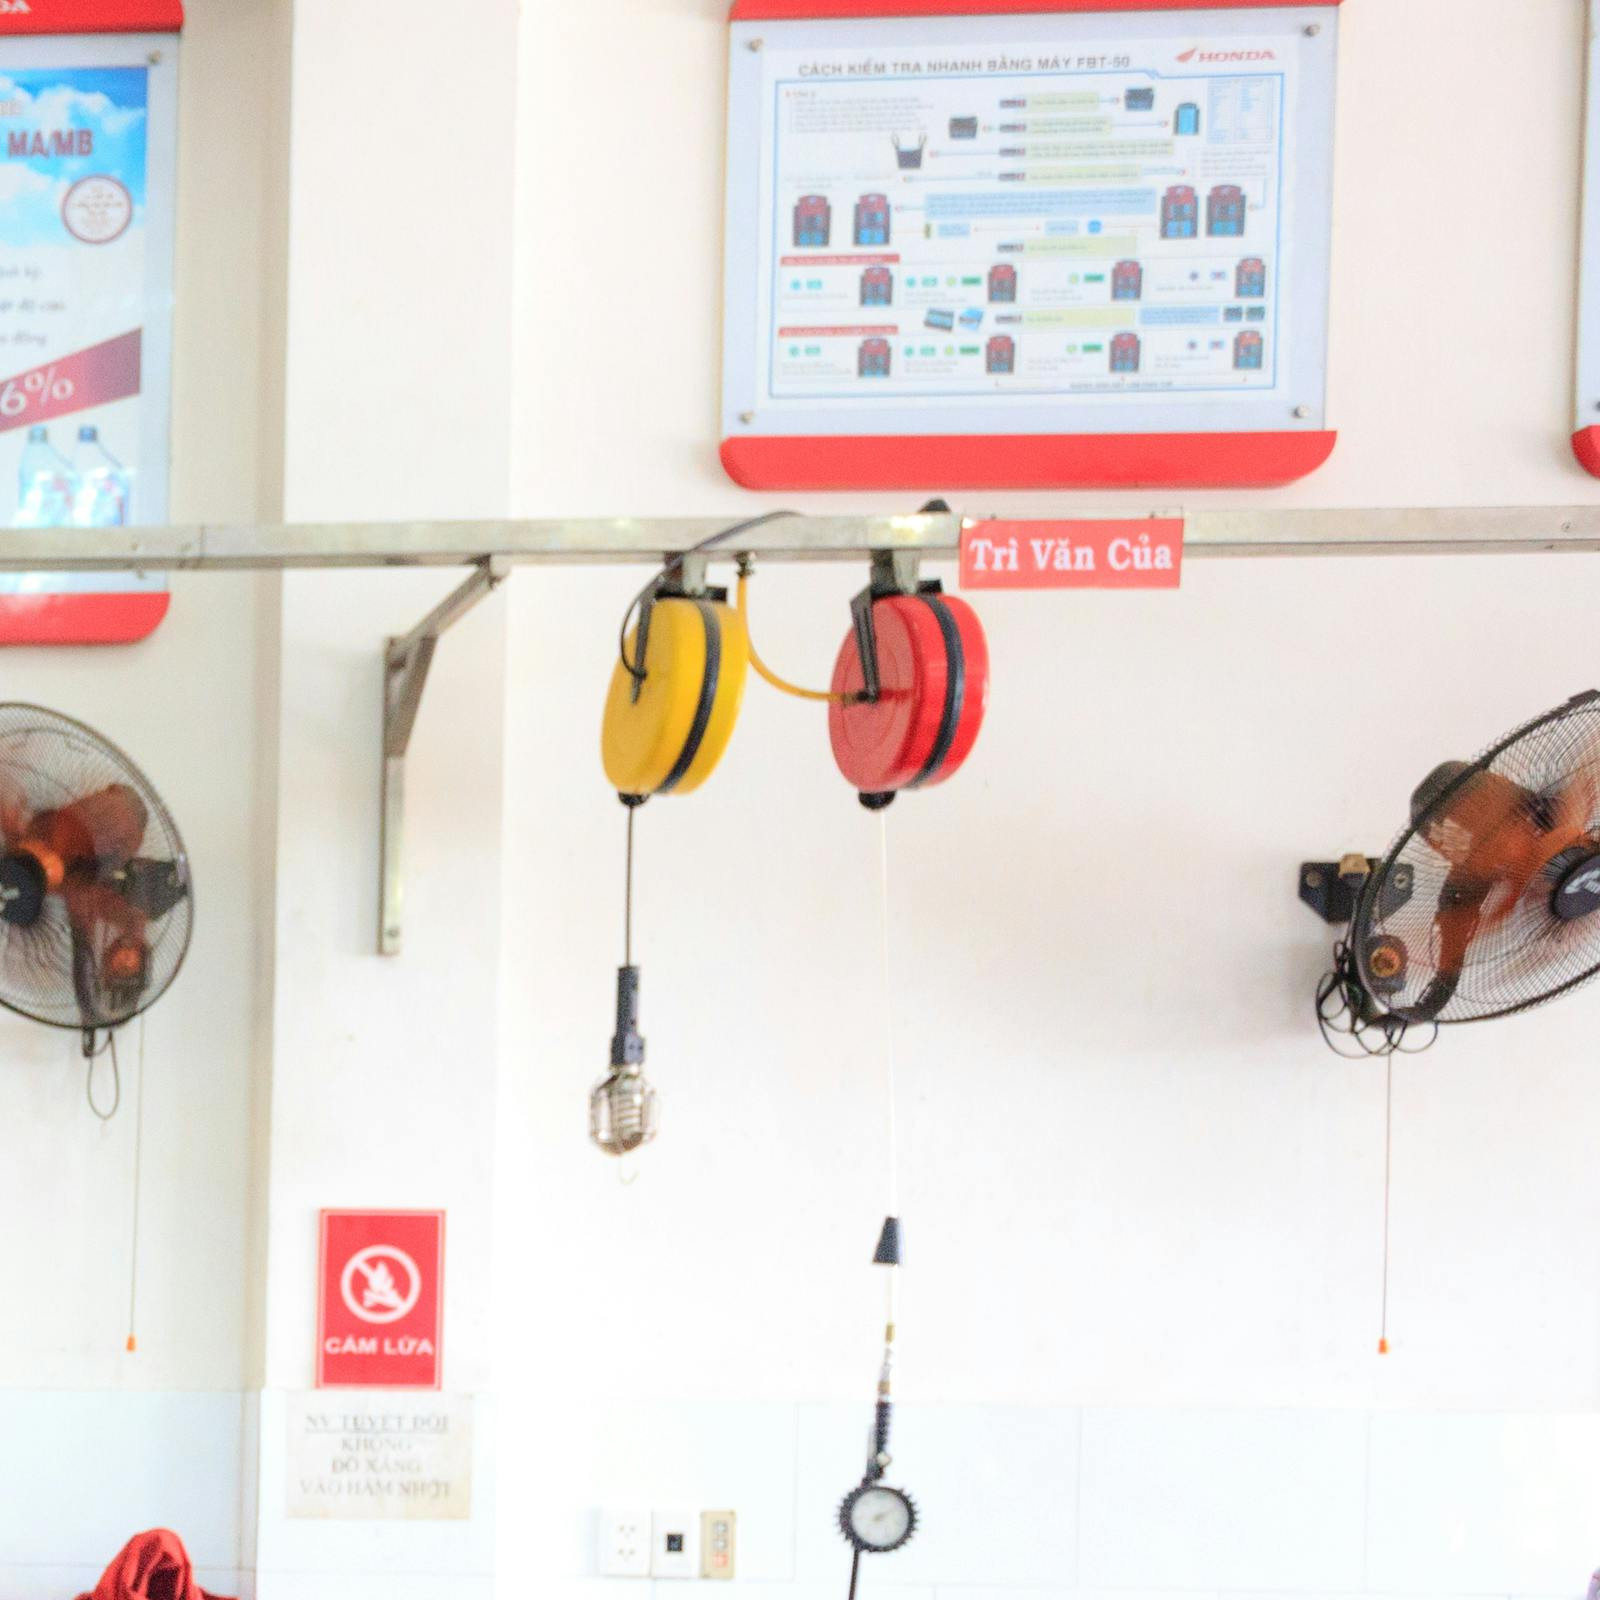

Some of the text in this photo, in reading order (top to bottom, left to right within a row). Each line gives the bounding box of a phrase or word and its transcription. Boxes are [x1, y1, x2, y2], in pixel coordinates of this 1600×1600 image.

[798, 61, 844, 77] CÁCH
[891, 61, 922, 74] TRA
[927, 60, 982, 73] NHANH
[1199, 49, 1276, 63] HONDA
[8, 129, 94, 158] MA/MB
[0, 366, 75, 418] 6%
[1030, 537, 1096, 572] Văn
[1107, 532, 1174, 572] Của
[325, 1335, 434, 1356] CẤM LỬA
